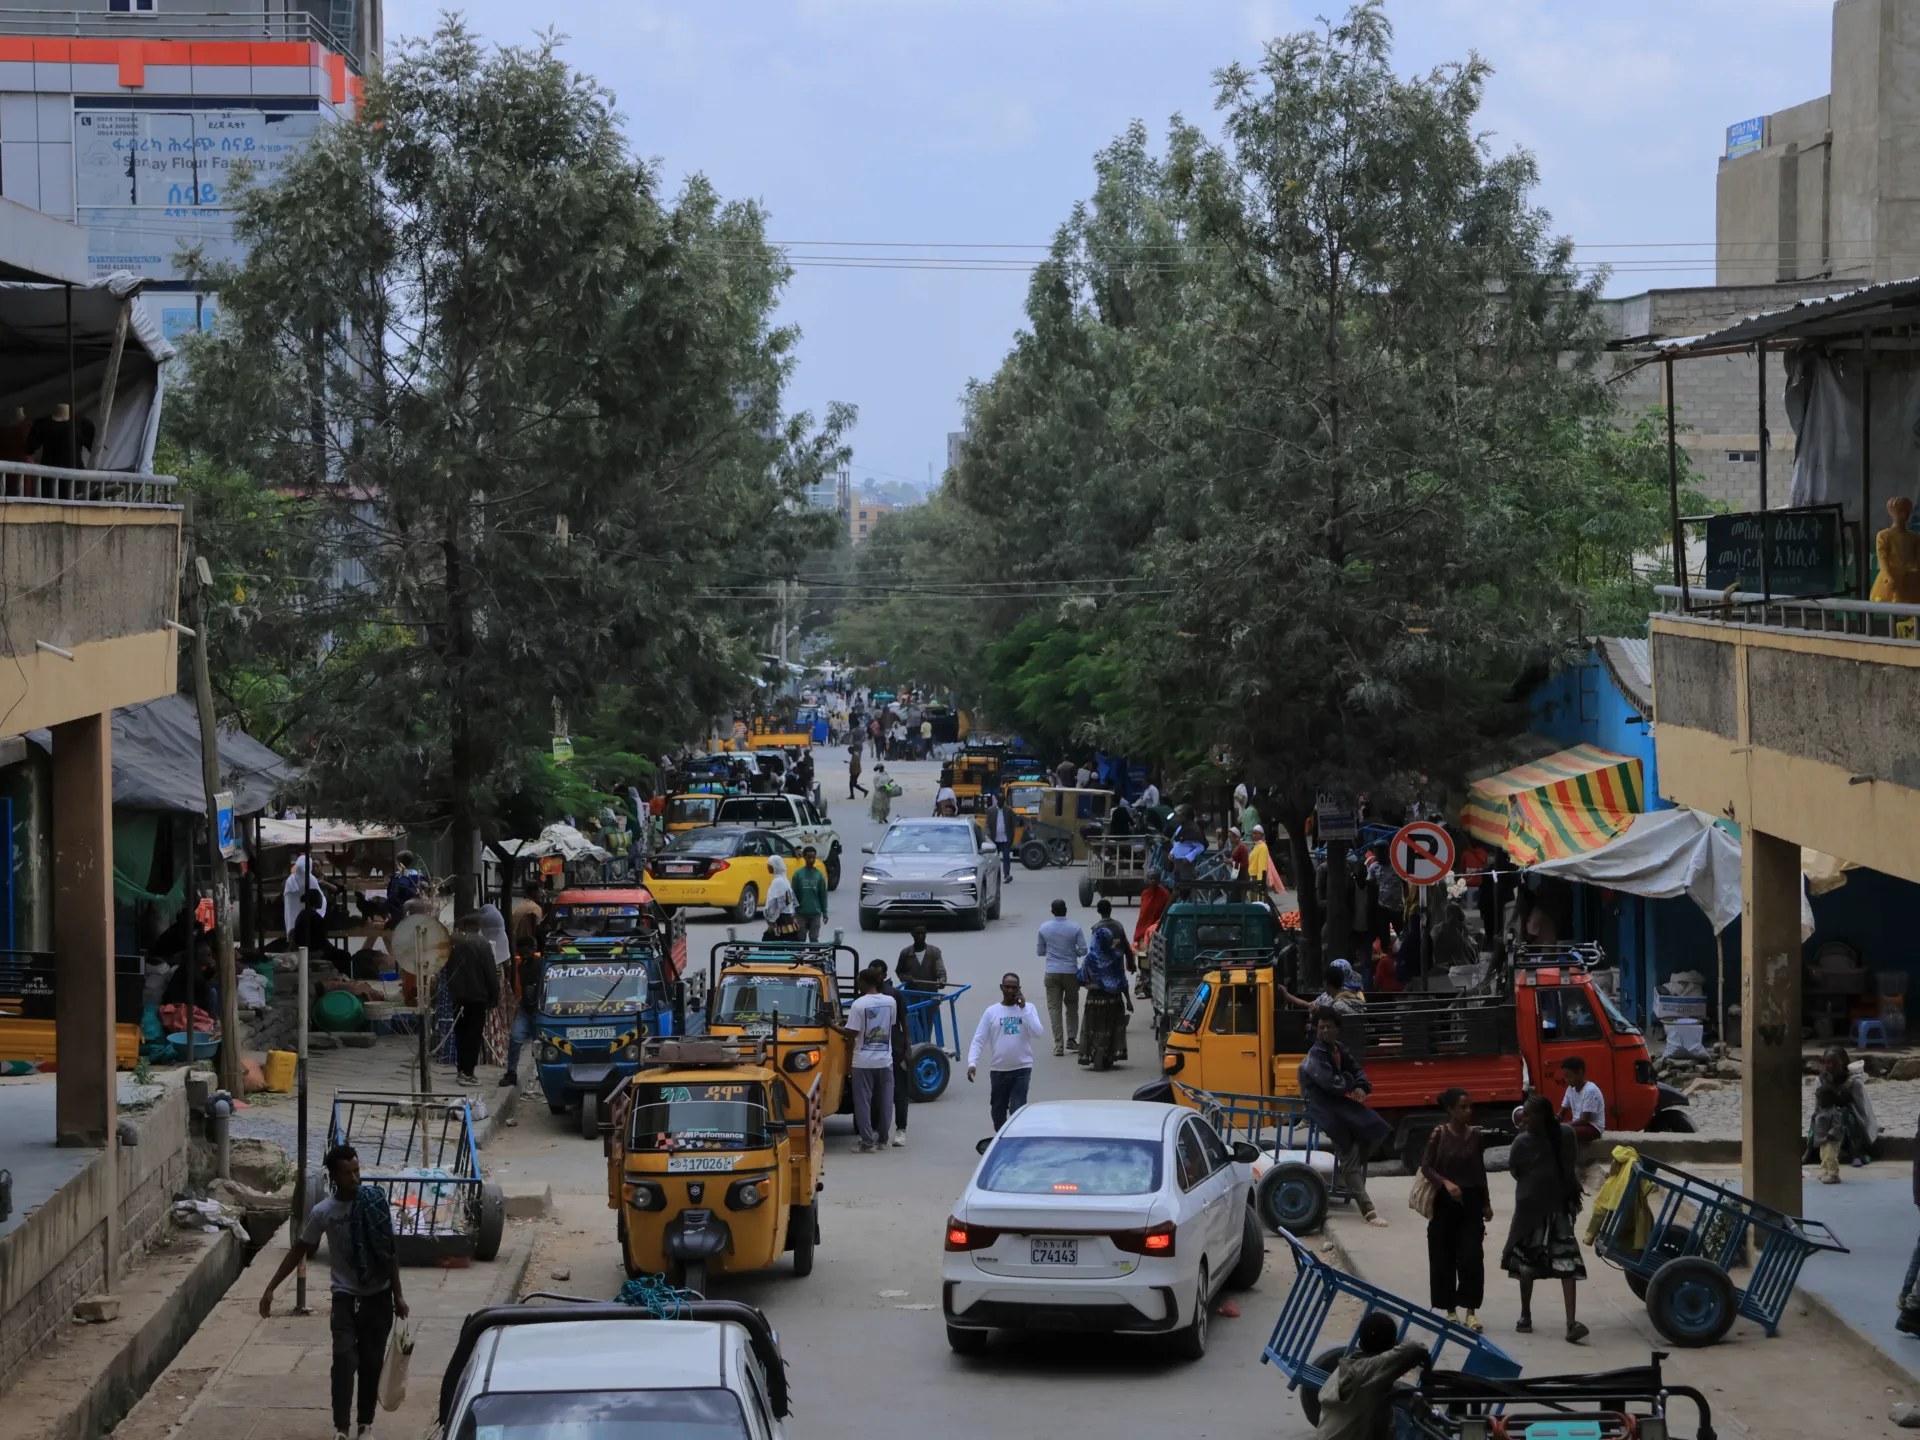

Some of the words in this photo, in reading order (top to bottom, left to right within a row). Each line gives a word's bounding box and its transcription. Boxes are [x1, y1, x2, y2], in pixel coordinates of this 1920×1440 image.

[172, 157, 208, 170] Flour
[689, 1158, 722, 1170] 17026
[1032, 1249, 1076, 1263] C74143
